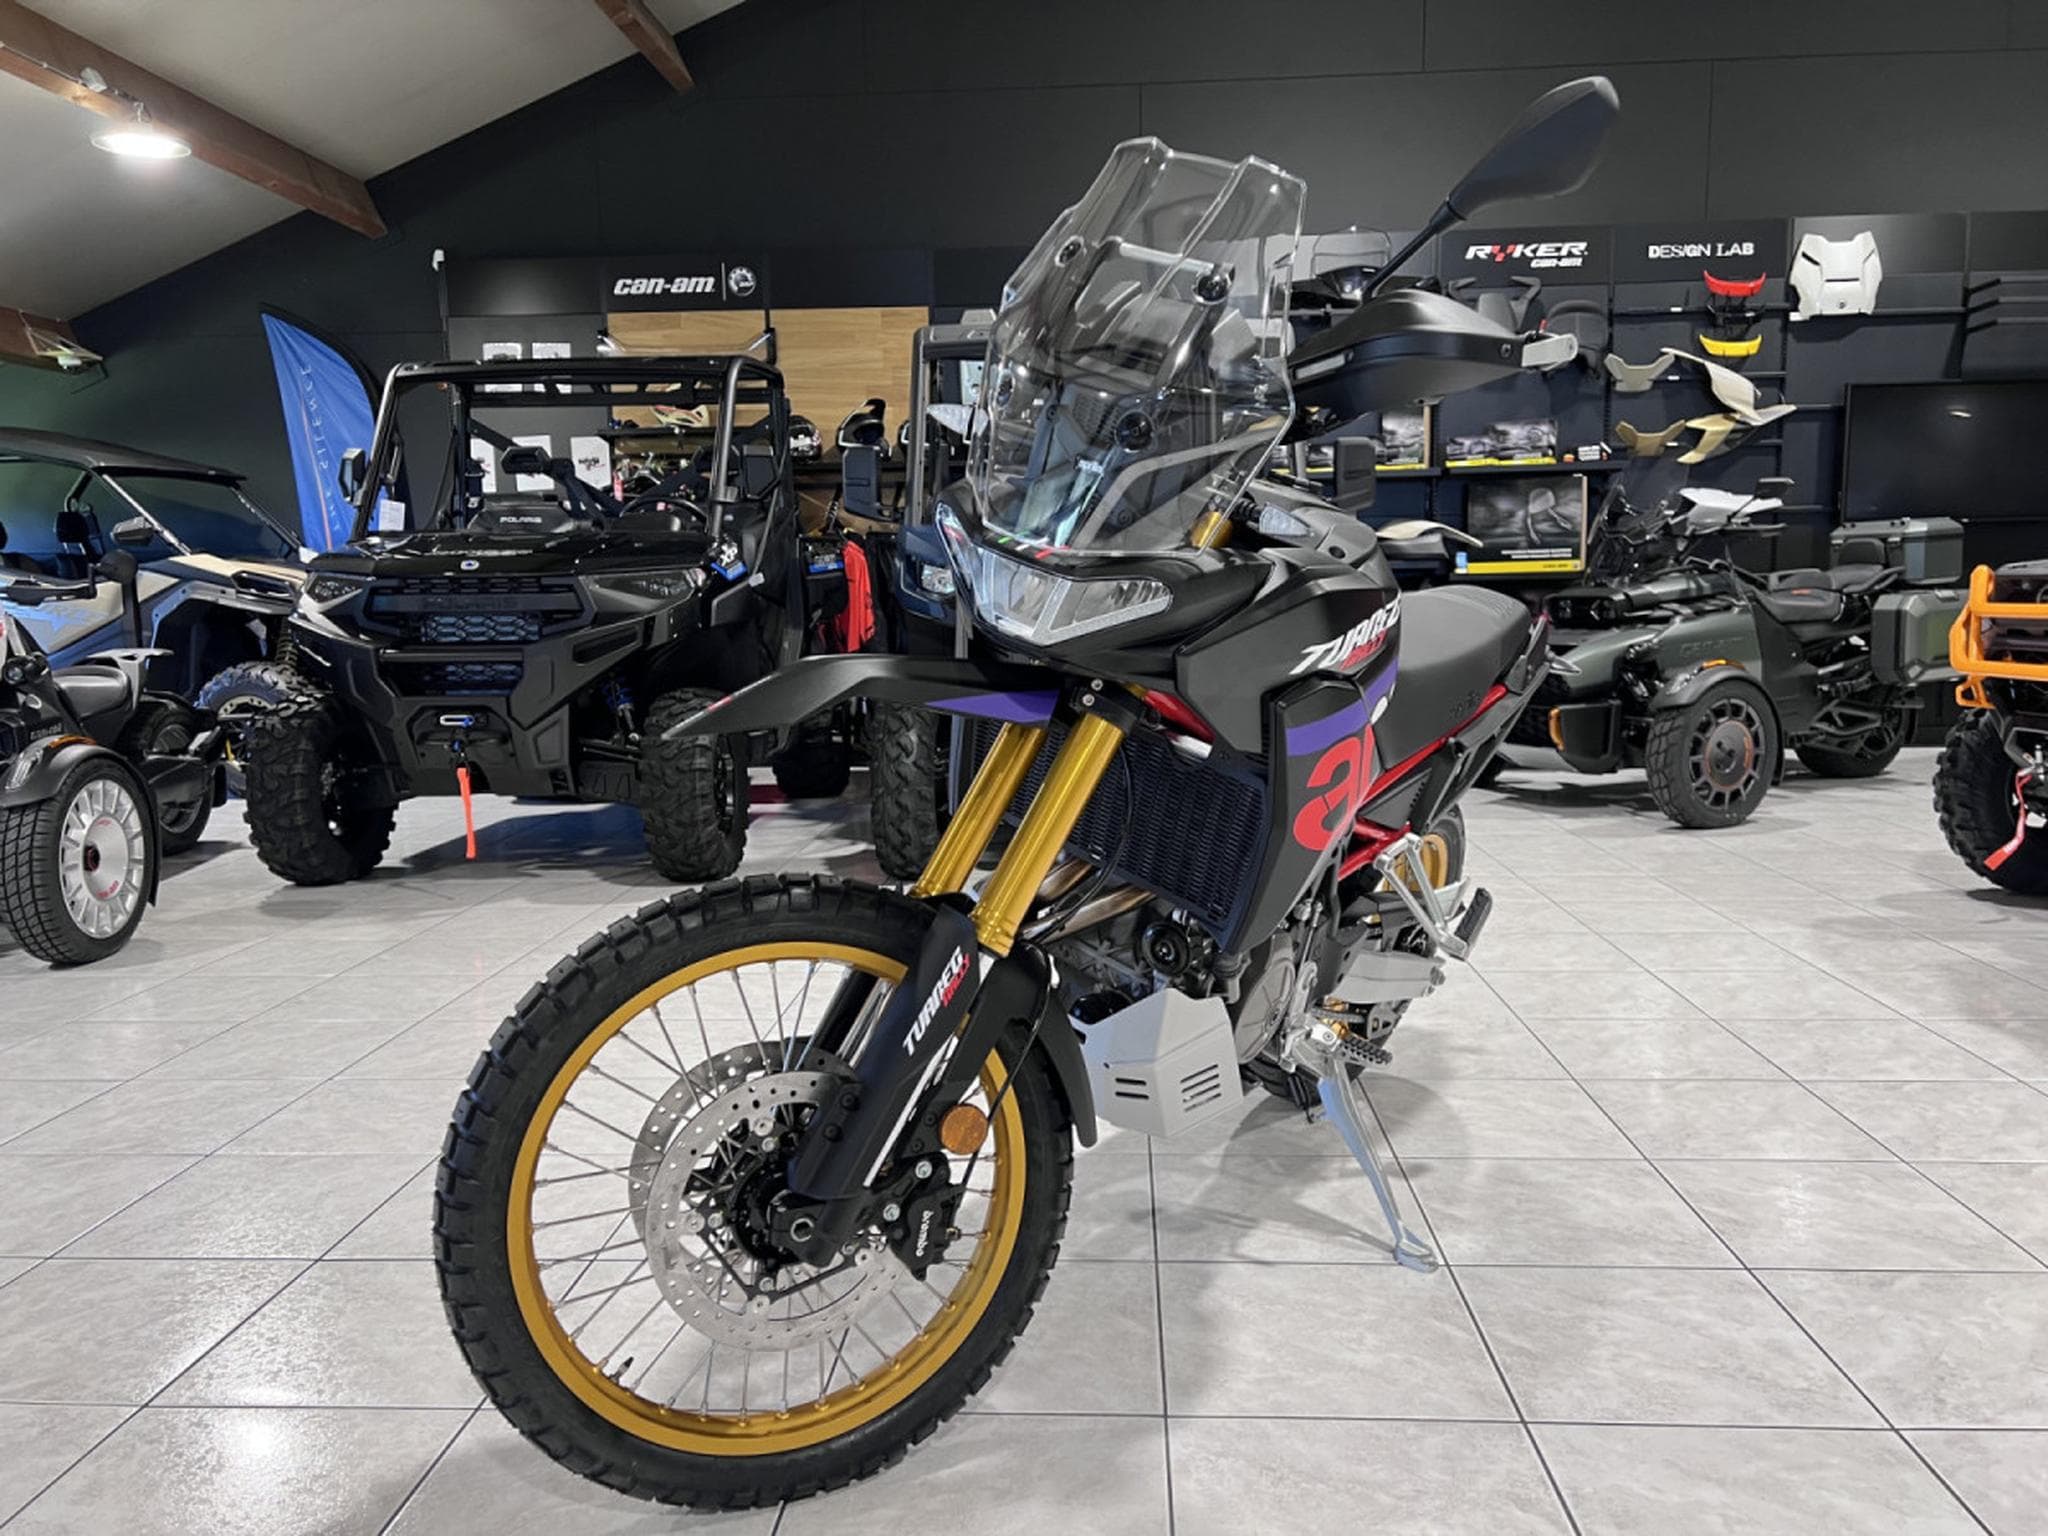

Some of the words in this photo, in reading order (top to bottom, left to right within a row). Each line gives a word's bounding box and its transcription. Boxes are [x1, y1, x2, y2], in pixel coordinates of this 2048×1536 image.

[1465, 242, 1588, 262] RYKER
[1648, 243, 1711, 259] DESIGN
[1716, 242, 1754, 257] LAB
[613, 276, 716, 295] can-am
[915, 1210, 934, 1257] brembo
